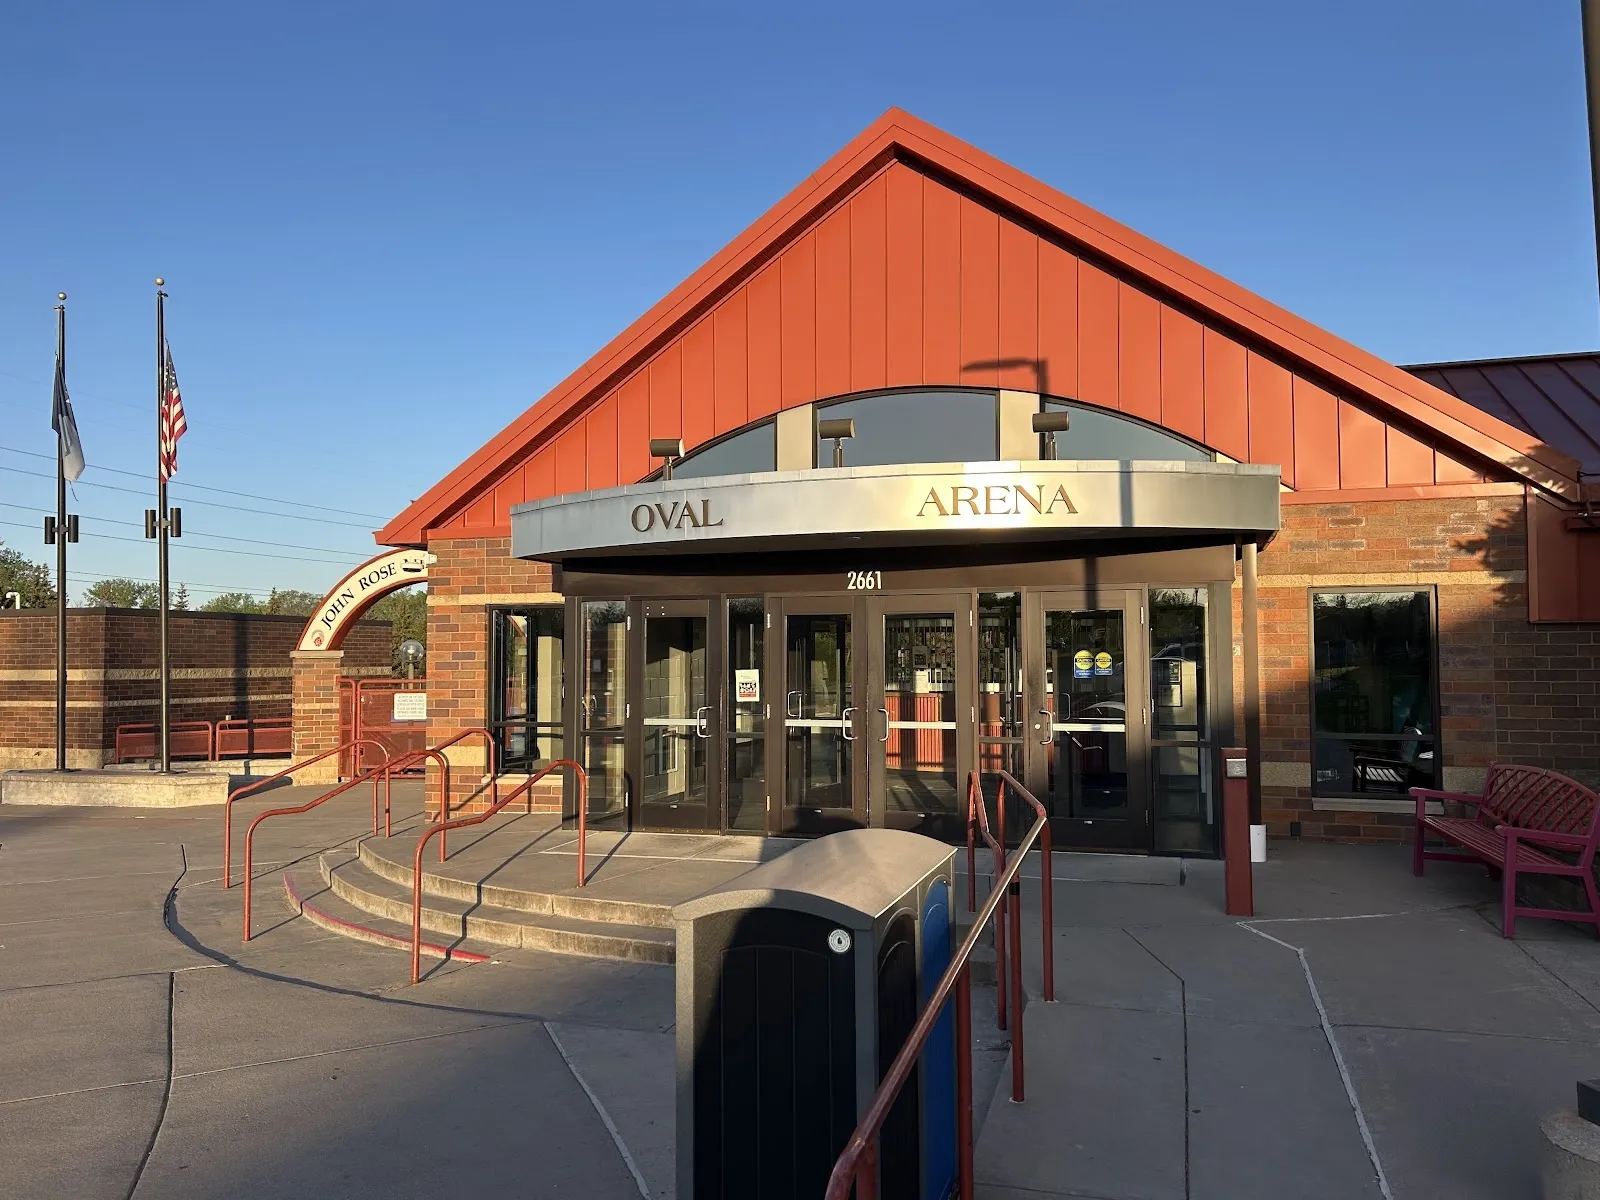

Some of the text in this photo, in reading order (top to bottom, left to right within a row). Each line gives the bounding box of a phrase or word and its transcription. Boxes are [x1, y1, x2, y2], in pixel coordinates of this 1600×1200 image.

[631, 483, 1079, 532] OVAL ARENA
[320, 562, 397, 631] JOHN ROSE
[847, 570, 882, 590] 2661
